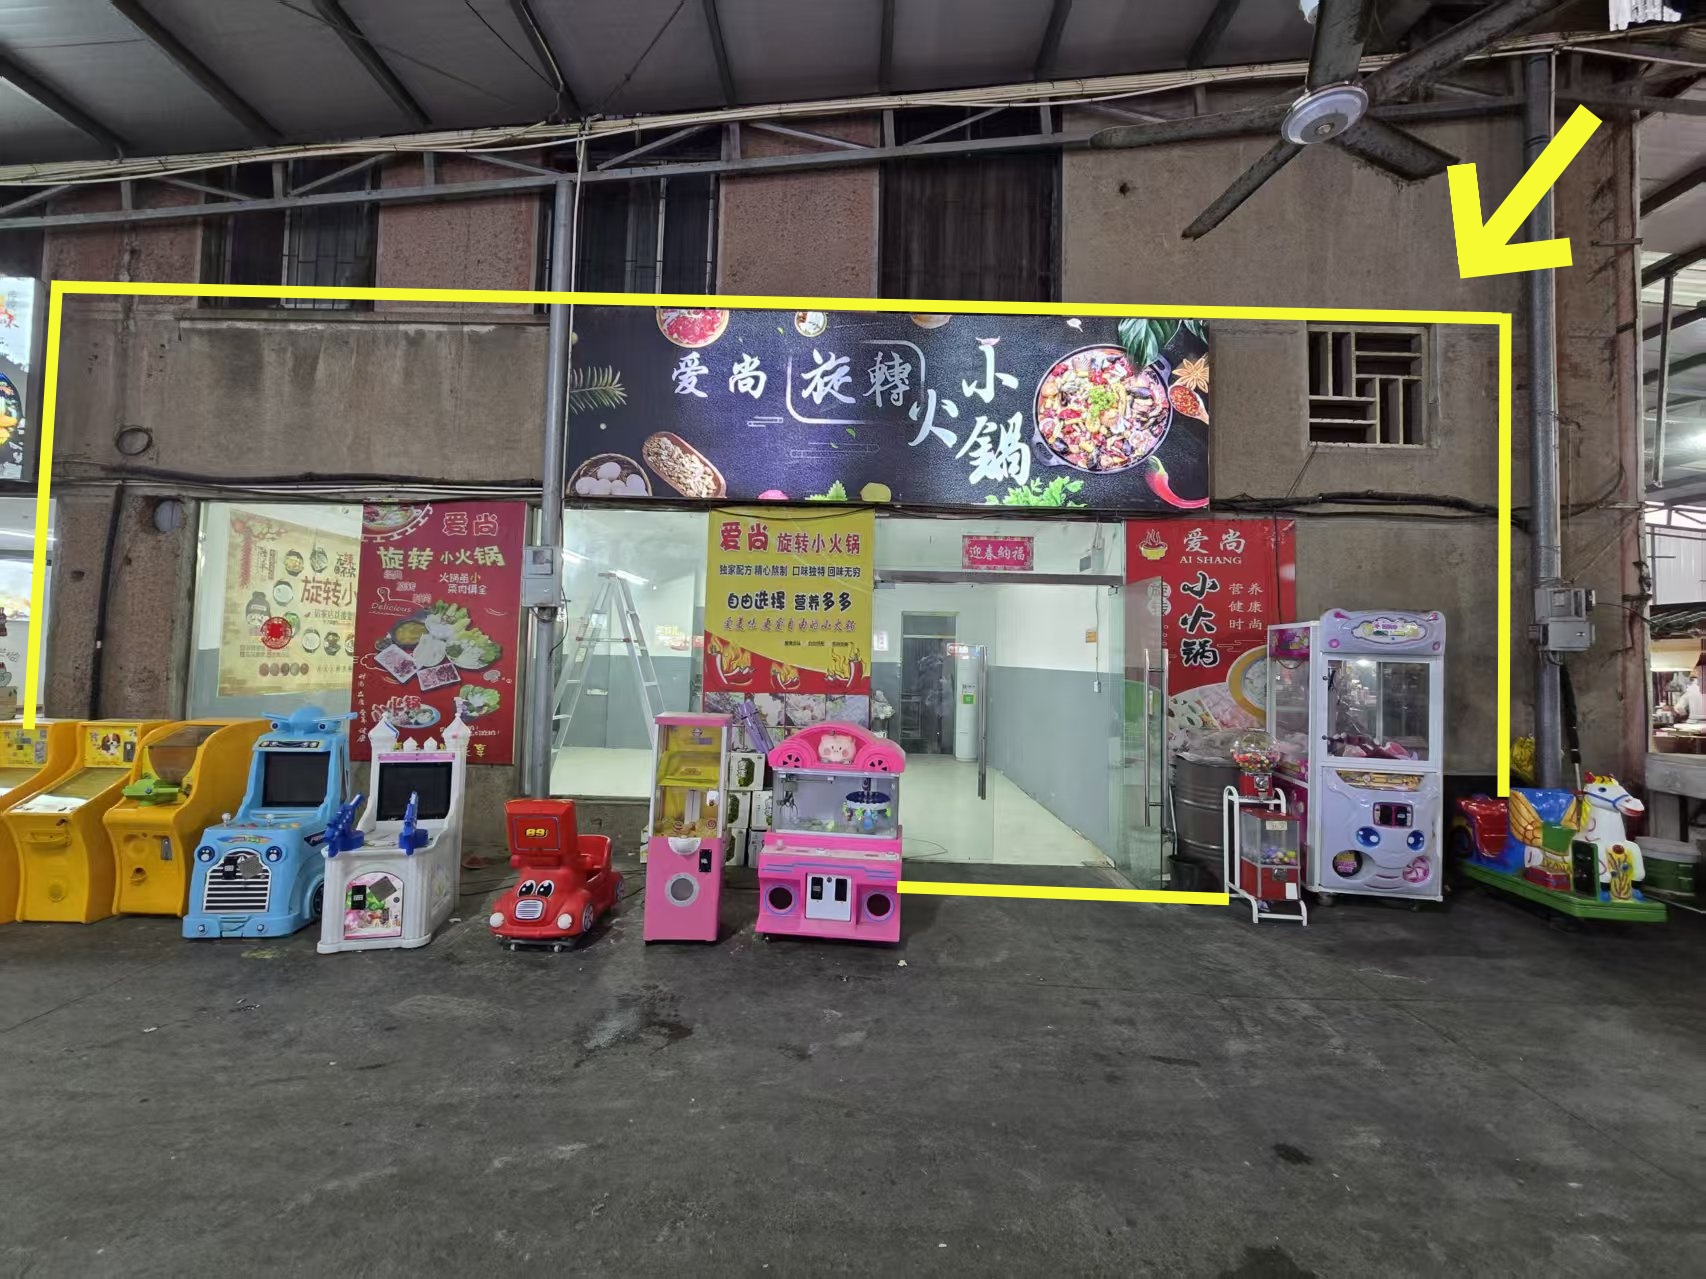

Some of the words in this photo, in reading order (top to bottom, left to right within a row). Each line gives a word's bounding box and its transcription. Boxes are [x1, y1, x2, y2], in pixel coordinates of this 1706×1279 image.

[671, 351, 767, 398] 爱尚
[442, 512, 499, 536] 爱尚
[720, 521, 769, 551] 爱尚
[777, 533, 861, 554] 旋转小火锅
[1183, 527, 1246, 554] 爱尚
[377, 546, 434, 570] 旋转
[440, 545, 506, 566] 小火锅
[1180, 556, 1193, 564] AI
[1196, 556, 1242, 565] SHANG
[719, 564, 752, 576] 独家配方
[754, 564, 788, 576] 精心熬制
[792, 566, 825, 577] 口味独特
[827, 566, 861, 578] 回味无穷
[727, 590, 786, 610] 自由选择
[794, 591, 852, 611] 营养多多
[1228, 583, 1264, 596] 营养
[1228, 600, 1263, 613] 健康
[1179, 571, 1220, 668] 小火锅
[1229, 618, 1263, 631] 时尚
